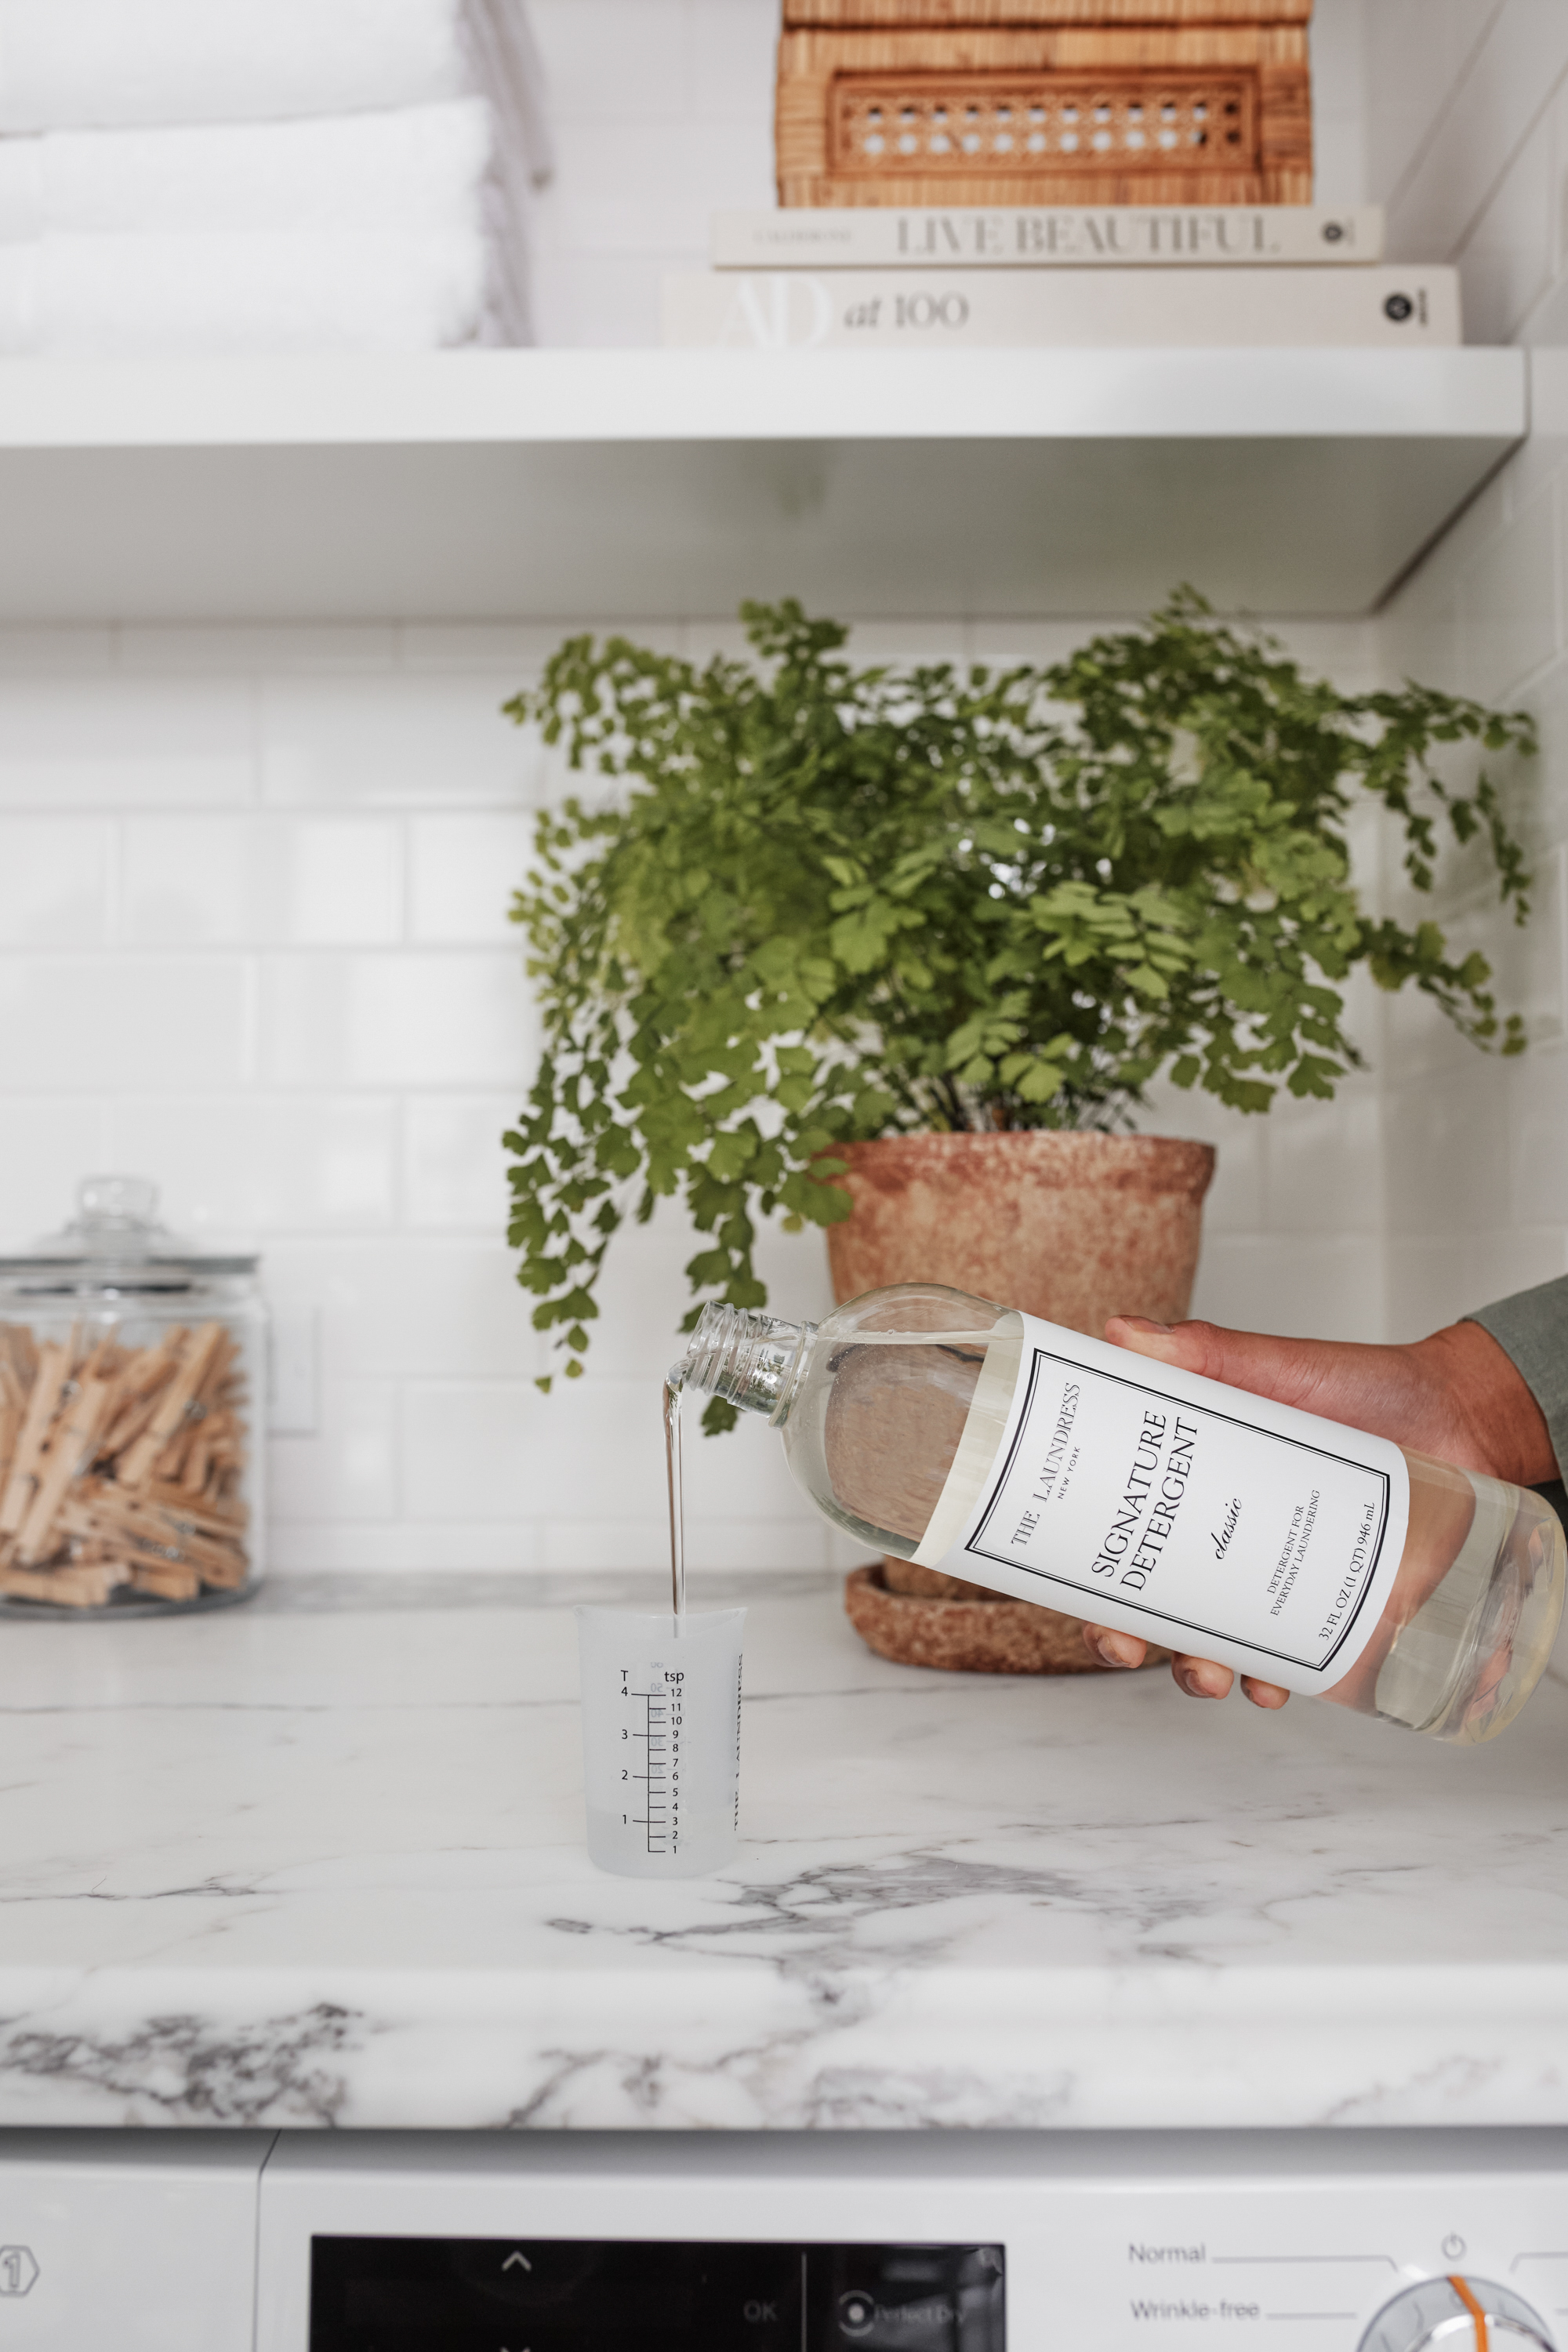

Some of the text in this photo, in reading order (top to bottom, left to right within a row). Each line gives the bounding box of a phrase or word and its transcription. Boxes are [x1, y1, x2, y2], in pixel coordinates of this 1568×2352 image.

[898, 213, 1281, 255] LIVE BEAUTIFUL
[843, 294, 883, 330] at
[895, 290, 971, 330] 100
[1011, 1382, 1080, 1545] THE LAUNDRESS
[1058, 1446, 1080, 1499] NEW YORK
[1091, 1410, 1167, 1577] SIGNATURE
[1120, 1417, 1197, 1591] DETERGENT
[1211, 1498, 1242, 1559] classic
[1267, 1505, 1305, 1594] DETERGENT FOR
[1270, 1490, 1320, 1616] EVERYDAY LAUNDERING
[1319, 1502, 1374, 1641] 32 FL OZ (1 QT) 946 mL
[620, 1669, 684, 1684] T tsp
[621, 1686, 682, 1697] 4 12
[671, 1703, 681, 1711] 11
[671, 1716, 682, 1725] 10
[622, 1729, 678, 1740] 3 9
[673, 1744, 679, 1752] 8
[673, 1759, 678, 1767] 7
[622, 1769, 679, 1780] 2 6
[673, 1788, 678, 1796] 5
[673, 1802, 679, 1811] 4
[622, 1814, 678, 1825] 1 3
[673, 1831, 678, 1839] 2
[1128, 2242, 1206, 2265] Normal
[742, 2299, 778, 2323] OK
[1129, 2299, 1261, 2321] Wrinkle-free
